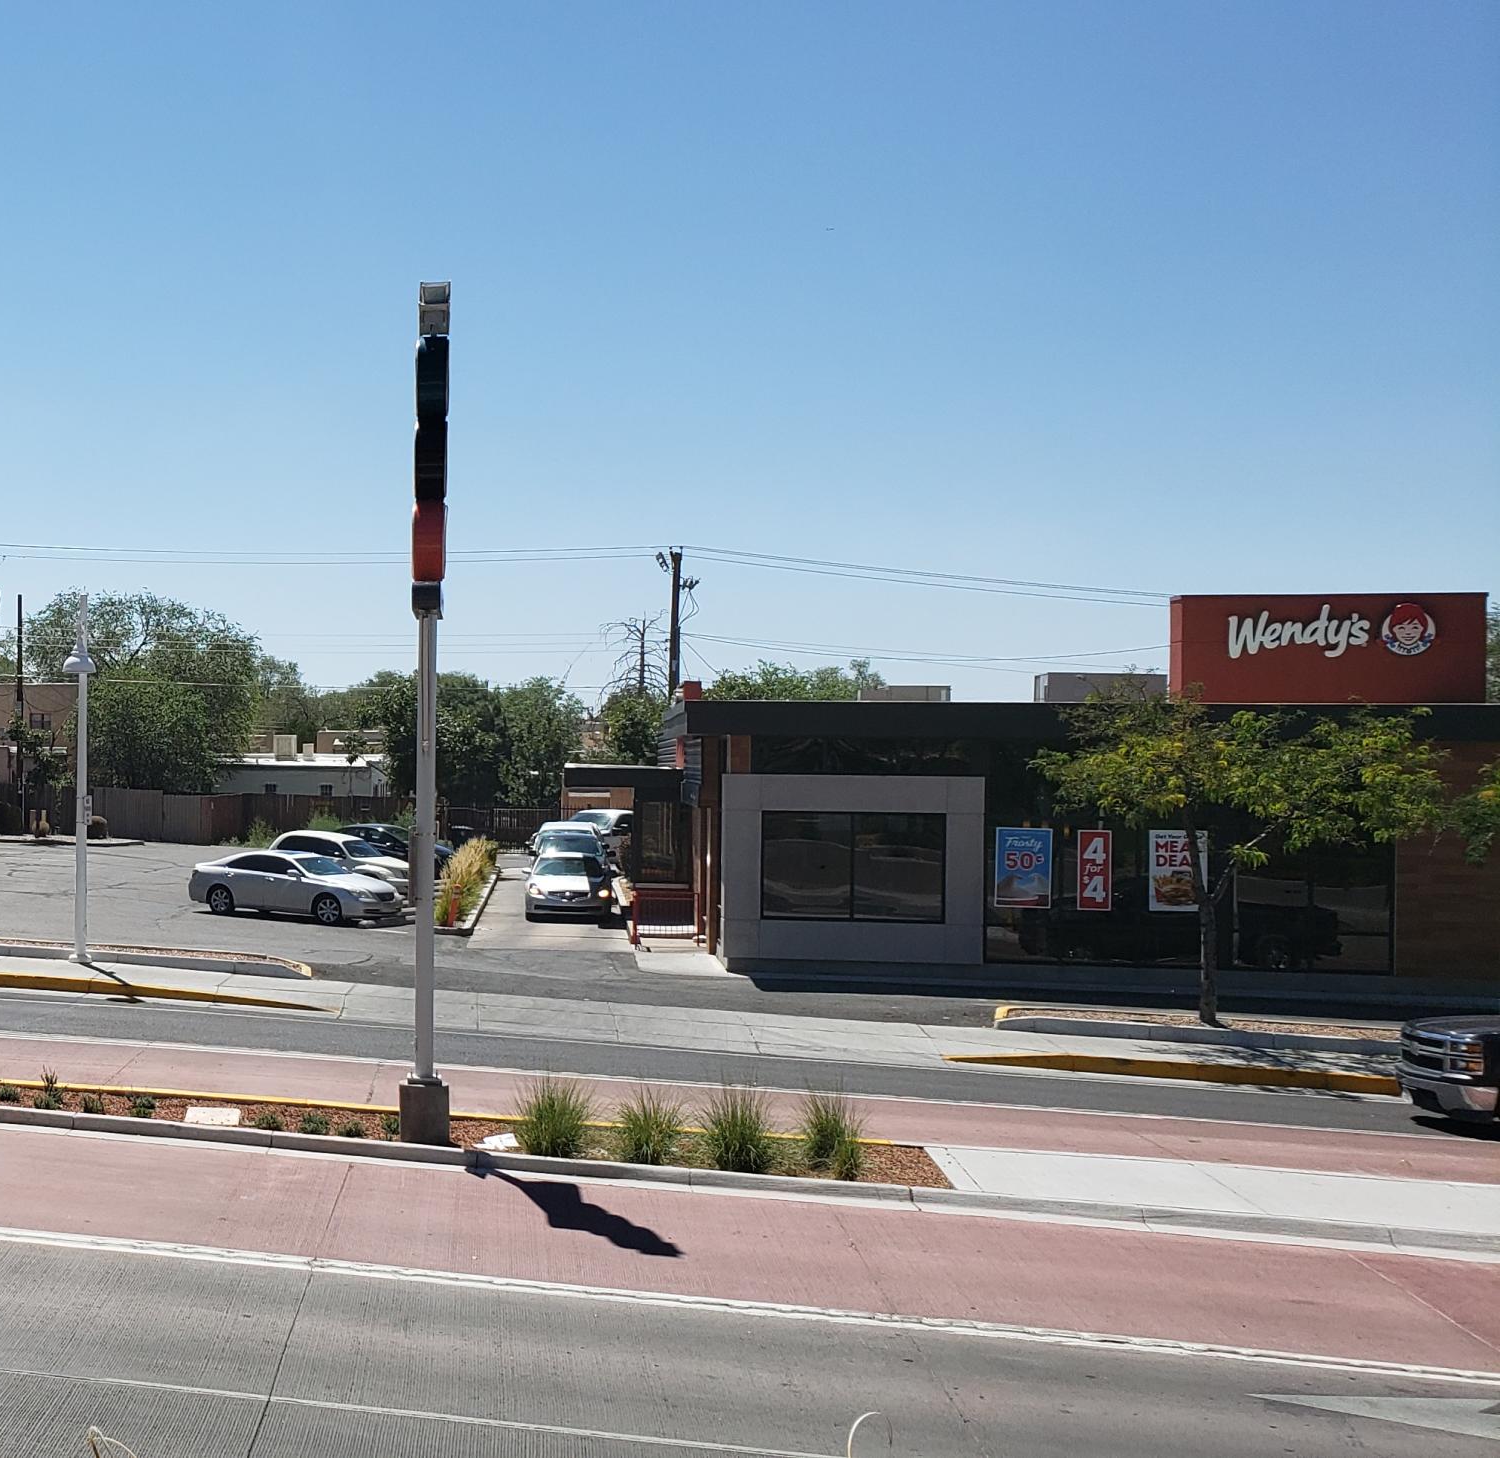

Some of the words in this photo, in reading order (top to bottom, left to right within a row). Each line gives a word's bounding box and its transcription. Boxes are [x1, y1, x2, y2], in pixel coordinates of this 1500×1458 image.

[1005, 836, 1043, 852] Frosty
[1083, 837, 1106, 864] 4
[1155, 840, 1190, 853] MEA
[1155, 854, 1192, 867] DEA
[1084, 863, 1104, 874] for
[1082, 875, 1106, 903] $4
